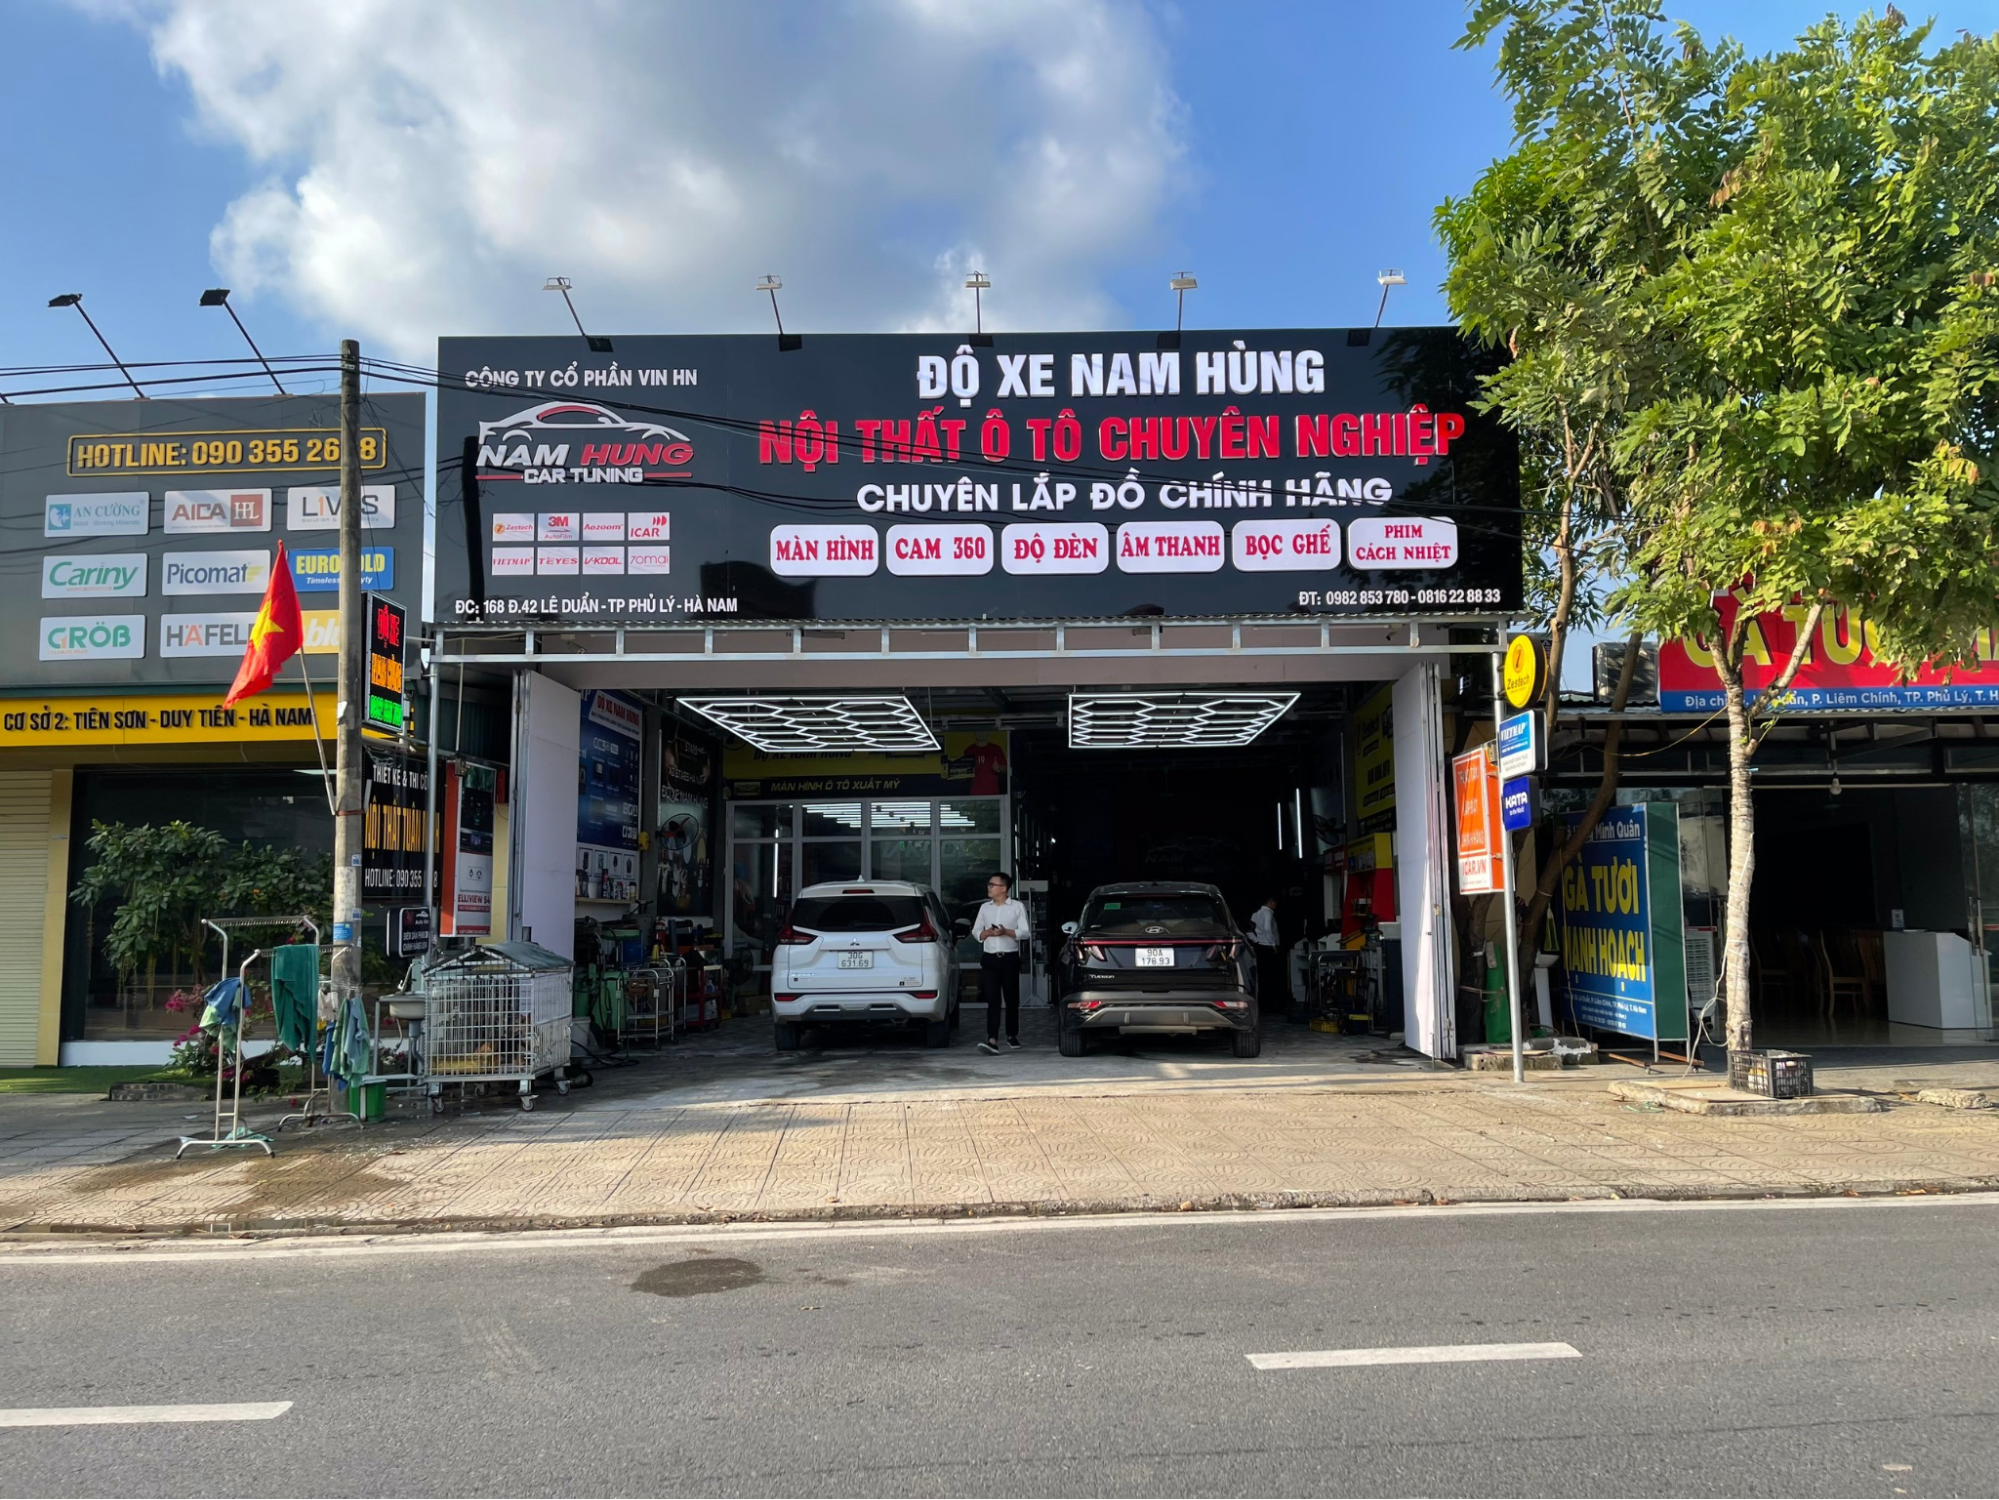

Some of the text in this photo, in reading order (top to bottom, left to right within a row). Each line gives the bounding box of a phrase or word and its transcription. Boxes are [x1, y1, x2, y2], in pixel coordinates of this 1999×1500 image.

[465, 361, 697, 387] CÔNG TY CỔ PHẦN VIN HN
[917, 340, 1325, 408] ĐỘ XE NAM HÙNG
[759, 403, 1465, 473] NỘI THẤT Ô TÔ CHUYÊN NGHIỆP
[77, 437, 378, 469] HOTLINE: 090 355 268
[476, 442, 694, 467] NAM HUNG
[524, 467, 643, 484] CAR TUNING
[857, 467, 1392, 513] CHUYÊN LẮP ĐỒ CHÍNH HÃNG
[73, 502, 140, 519] AN CƯỜNG
[233, 501, 260, 520] HPL
[302, 494, 379, 517] L1VS
[548, 516, 569, 527] 3M
[584, 523, 621, 531] Aozoom
[630, 527, 660, 538] ICAR
[1384, 525, 1423, 540] PHIM
[776, 534, 874, 561] MÀN HÌNH
[895, 536, 985, 560] CAM 360
[1013, 532, 1098, 564] ĐỘ ĐÈN
[1120, 532, 1220, 557] ÂM THANH
[1245, 523, 1332, 561] BỌC GHẾ
[1356, 541, 1451, 562] CÁCH NHIỆT
[295, 553, 385, 575] EUROLD
[493, 557, 531, 566] VIETMAP
[584, 556, 622, 565] V-KOOL
[49, 561, 140, 591] Cariny
[167, 562, 248, 585] Picomat
[455, 598, 480, 615] ĐC:
[484, 598, 504, 614] 168
[508, 598, 538, 614] Đ.42
[541, 595, 559, 614] LÊ
[561, 592, 599, 613] DUẨN
[608, 599, 626, 613] TP
[628, 594, 656, 613] PHỦ
[659, 593, 674, 612] LÝ
[684, 593, 704, 612] HÀ
[707, 598, 738, 612] NAM
[1299, 590, 1321, 606] ĐT:
[1326, 590, 1358, 606] 0982
[1360, 590, 1383, 605] 853
[1386, 589, 1409, 605] 780
[1418, 588, 1446, 604] 0816
[1449, 588, 1464, 604] 22
[1467, 588, 1482, 603] 88
[1484, 588, 1500, 603] 33
[166, 623, 254, 647] HÄFEL
[305, 618, 341, 648] blu
[1507, 673, 1530, 690] Zestech
[1685, 695, 1707, 709] Địa
[1812, 694, 1823, 705] P.
[1826, 693, 1857, 704] Liêm
[1861, 691, 1901, 706] Chính,
[1905, 691, 1923, 702] TP.
[1927, 689, 1950, 702] Phủ
[1954, 690, 1972, 704] Lý,
[1975, 690, 1986, 701] T.
[4, 711, 26, 731] CƠ
[30, 705, 51, 731] SỞ
[54, 713, 69, 730] 2:
[73, 707, 110, 731] TIÊN
[114, 710, 147, 729] SƠN
[160, 709, 194, 728] DUY
[199, 704, 236, 727] TIÊN
[249, 703, 271, 727] HÀ
[275, 706, 314, 726] NAM
[978, 755, 985, 764] 19
[836, 778, 850, 790] TÔ
[1505, 791, 1528, 809] KATA
[365, 795, 381, 860] NỘI
[1595, 819, 1640, 839] Minh Quân
[365, 867, 395, 887] HOTLINE:
[396, 868, 409, 888] 090
[1563, 852, 1640, 915] GÀ TƯƠI
[841, 959, 869, 967] 631.69
[848, 951, 863, 959] 30G
[1147, 949, 1163, 957] 90A
[1563, 925, 1646, 992] MẠNH HOẠCH
